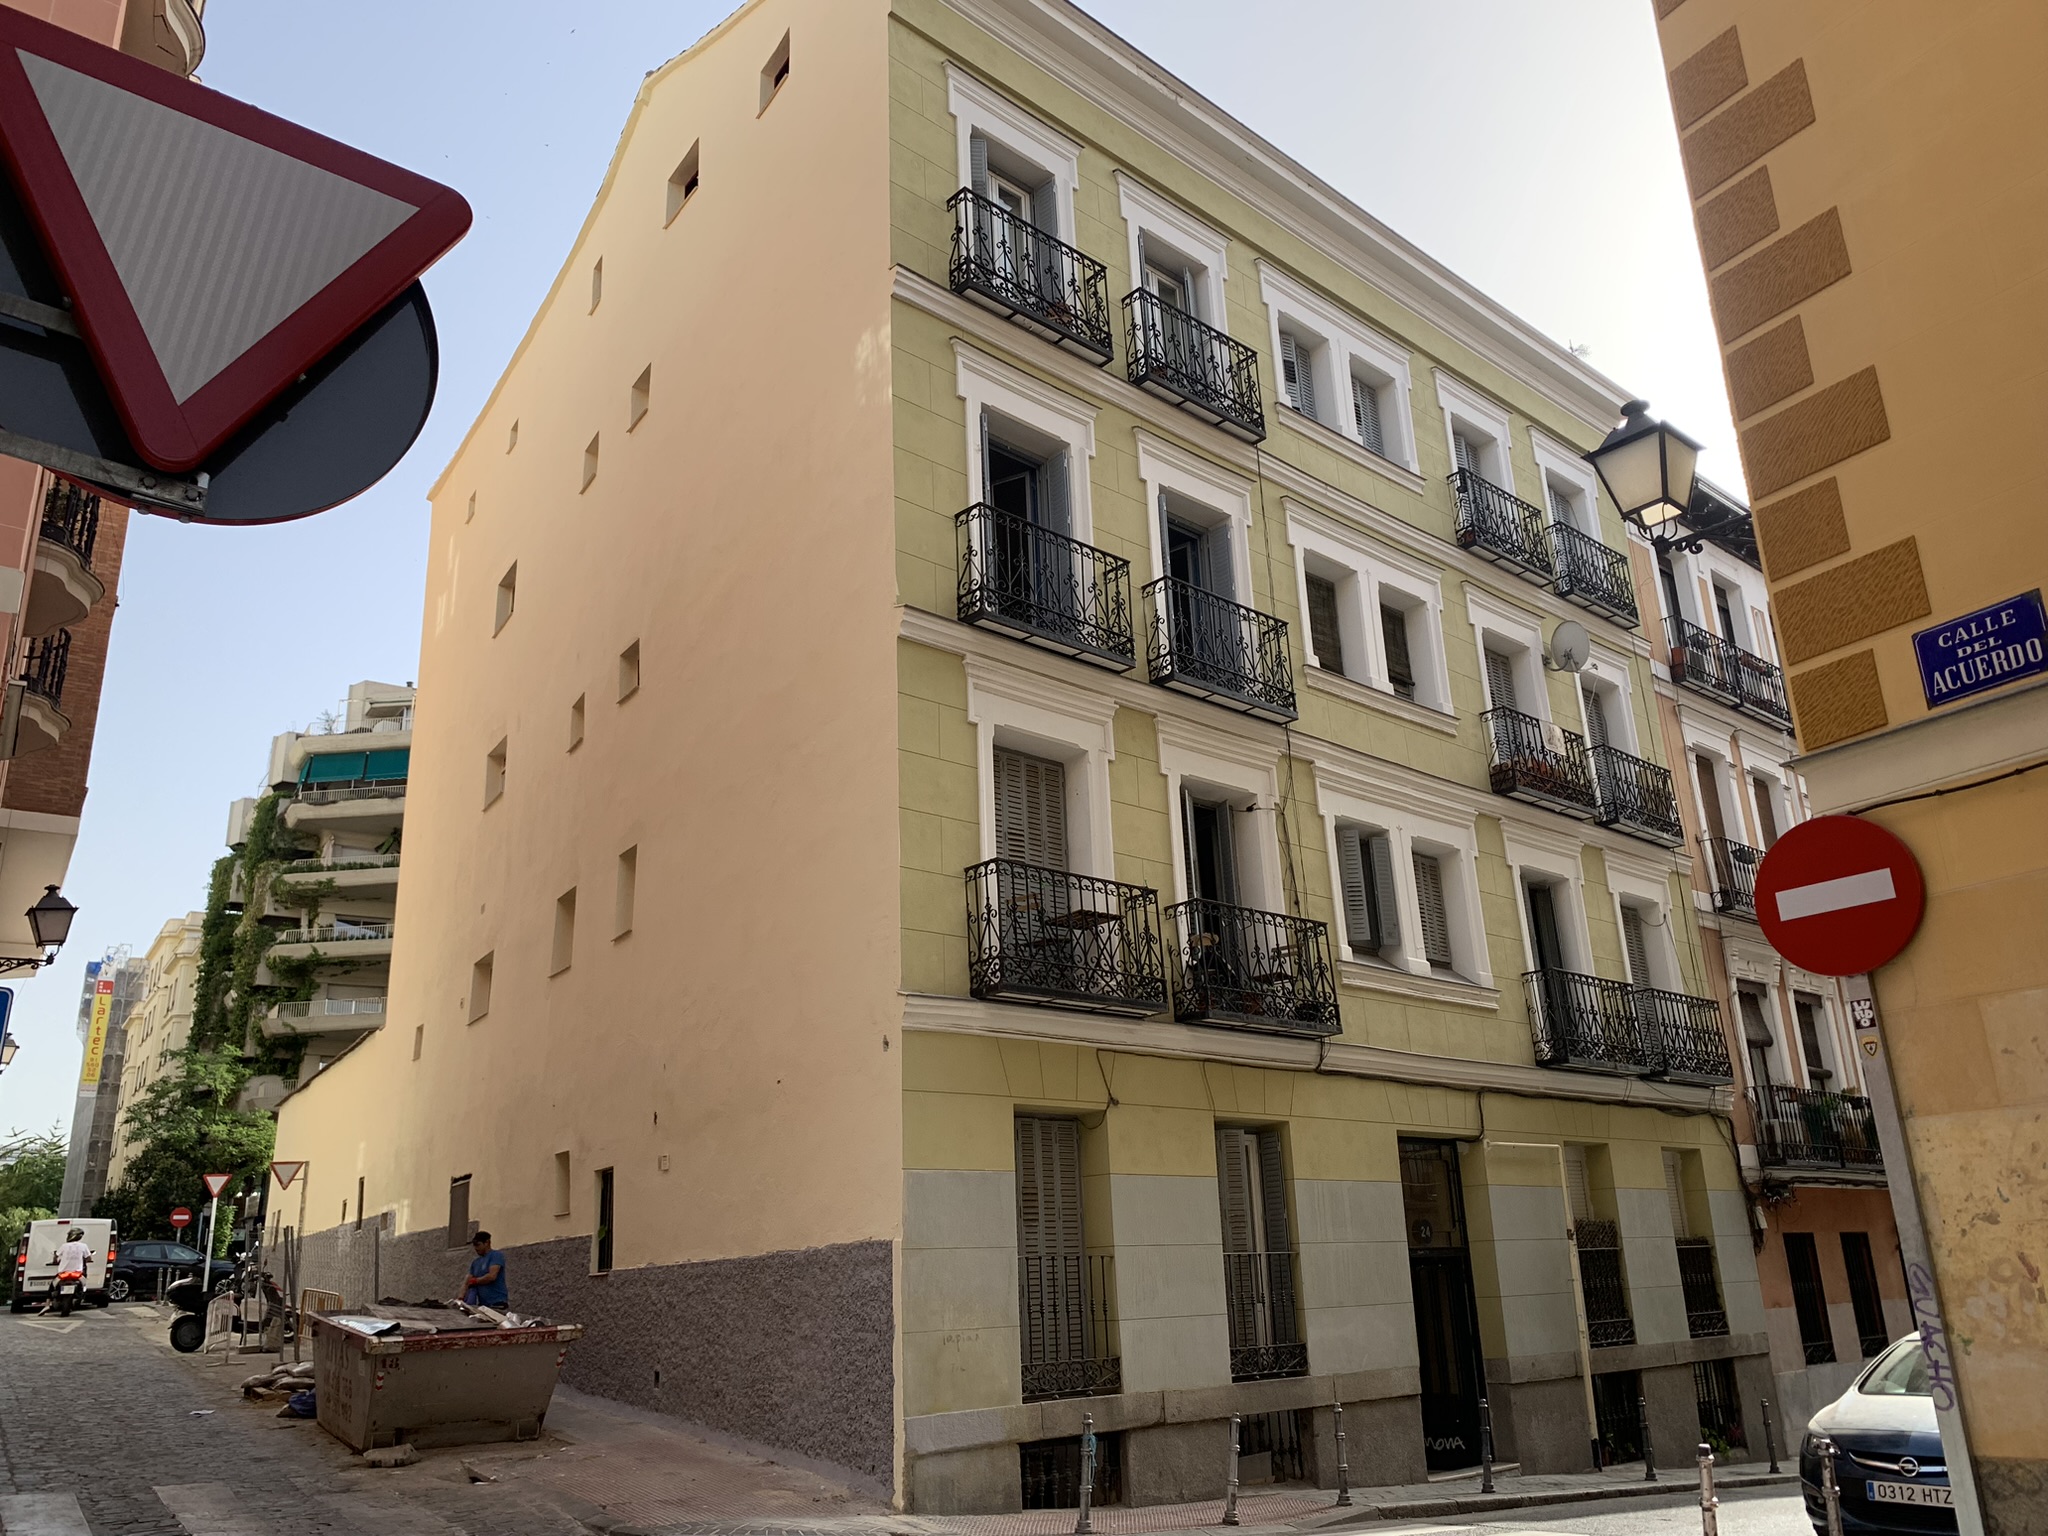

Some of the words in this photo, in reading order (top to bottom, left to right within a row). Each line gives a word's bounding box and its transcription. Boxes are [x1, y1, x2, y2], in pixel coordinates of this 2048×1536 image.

[1938, 608, 2016, 648] CALLE
[1956, 636, 2002, 658] DEL
[1933, 637, 2044, 696] ACUERDO
[91, 995, 106, 1056] Lartec
[1420, 1226, 1431, 1238] 24
[1877, 1483, 1916, 1503] 0312
[1922, 1488, 1953, 1505] HTZ
